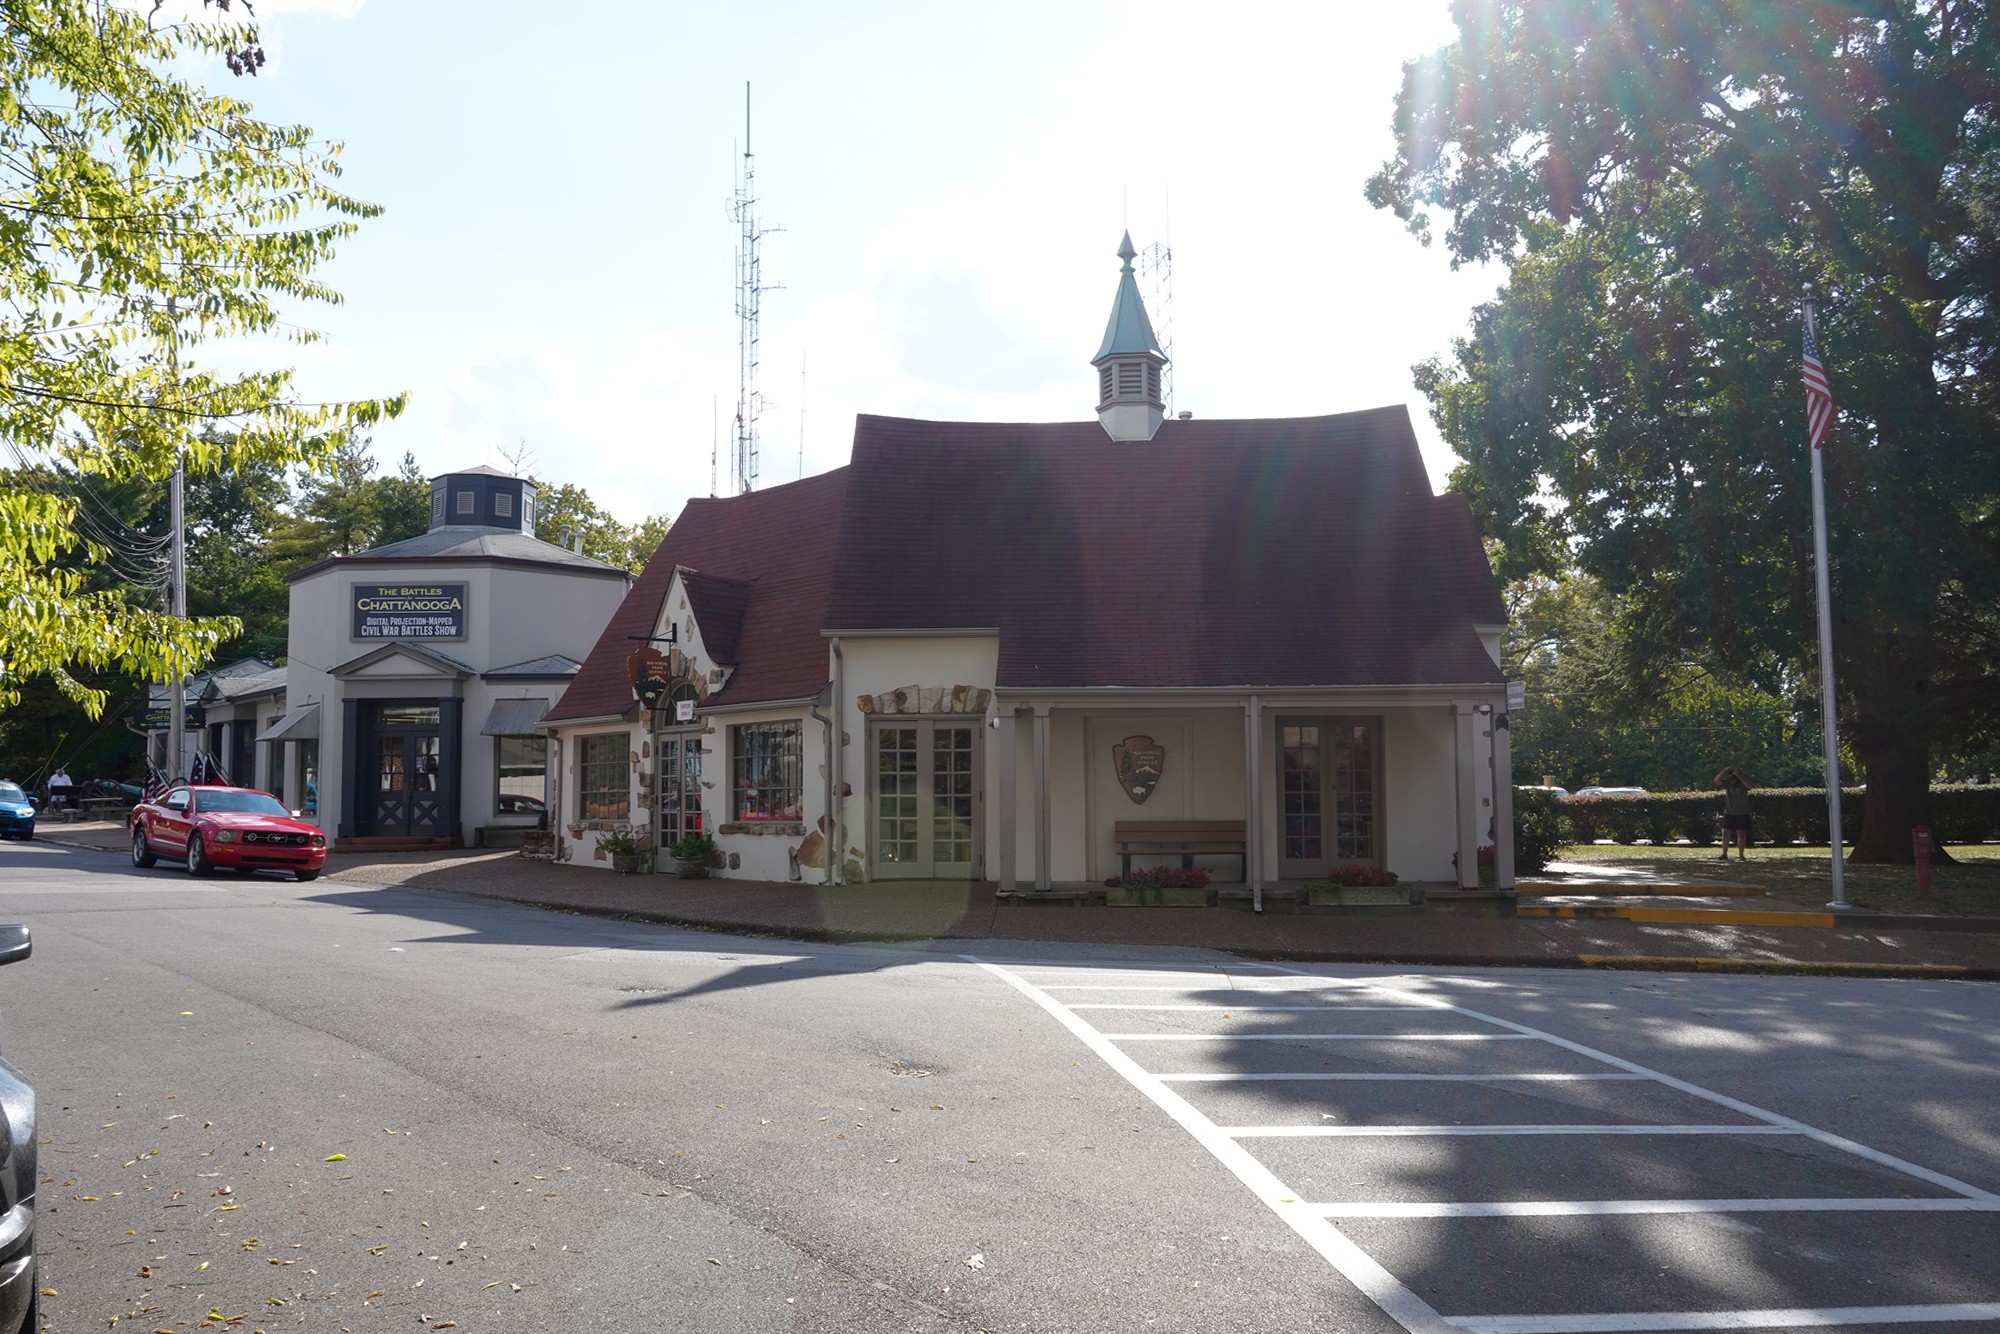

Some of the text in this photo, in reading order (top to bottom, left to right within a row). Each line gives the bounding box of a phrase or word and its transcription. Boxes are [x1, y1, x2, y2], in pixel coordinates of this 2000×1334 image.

[357, 598, 462, 611] CHATTANOOGA
[366, 616, 453, 626] DIGITAL PROJECTION-MAPPED
[361, 625, 457, 636] CIVIL WAR BATTLES SHOW
